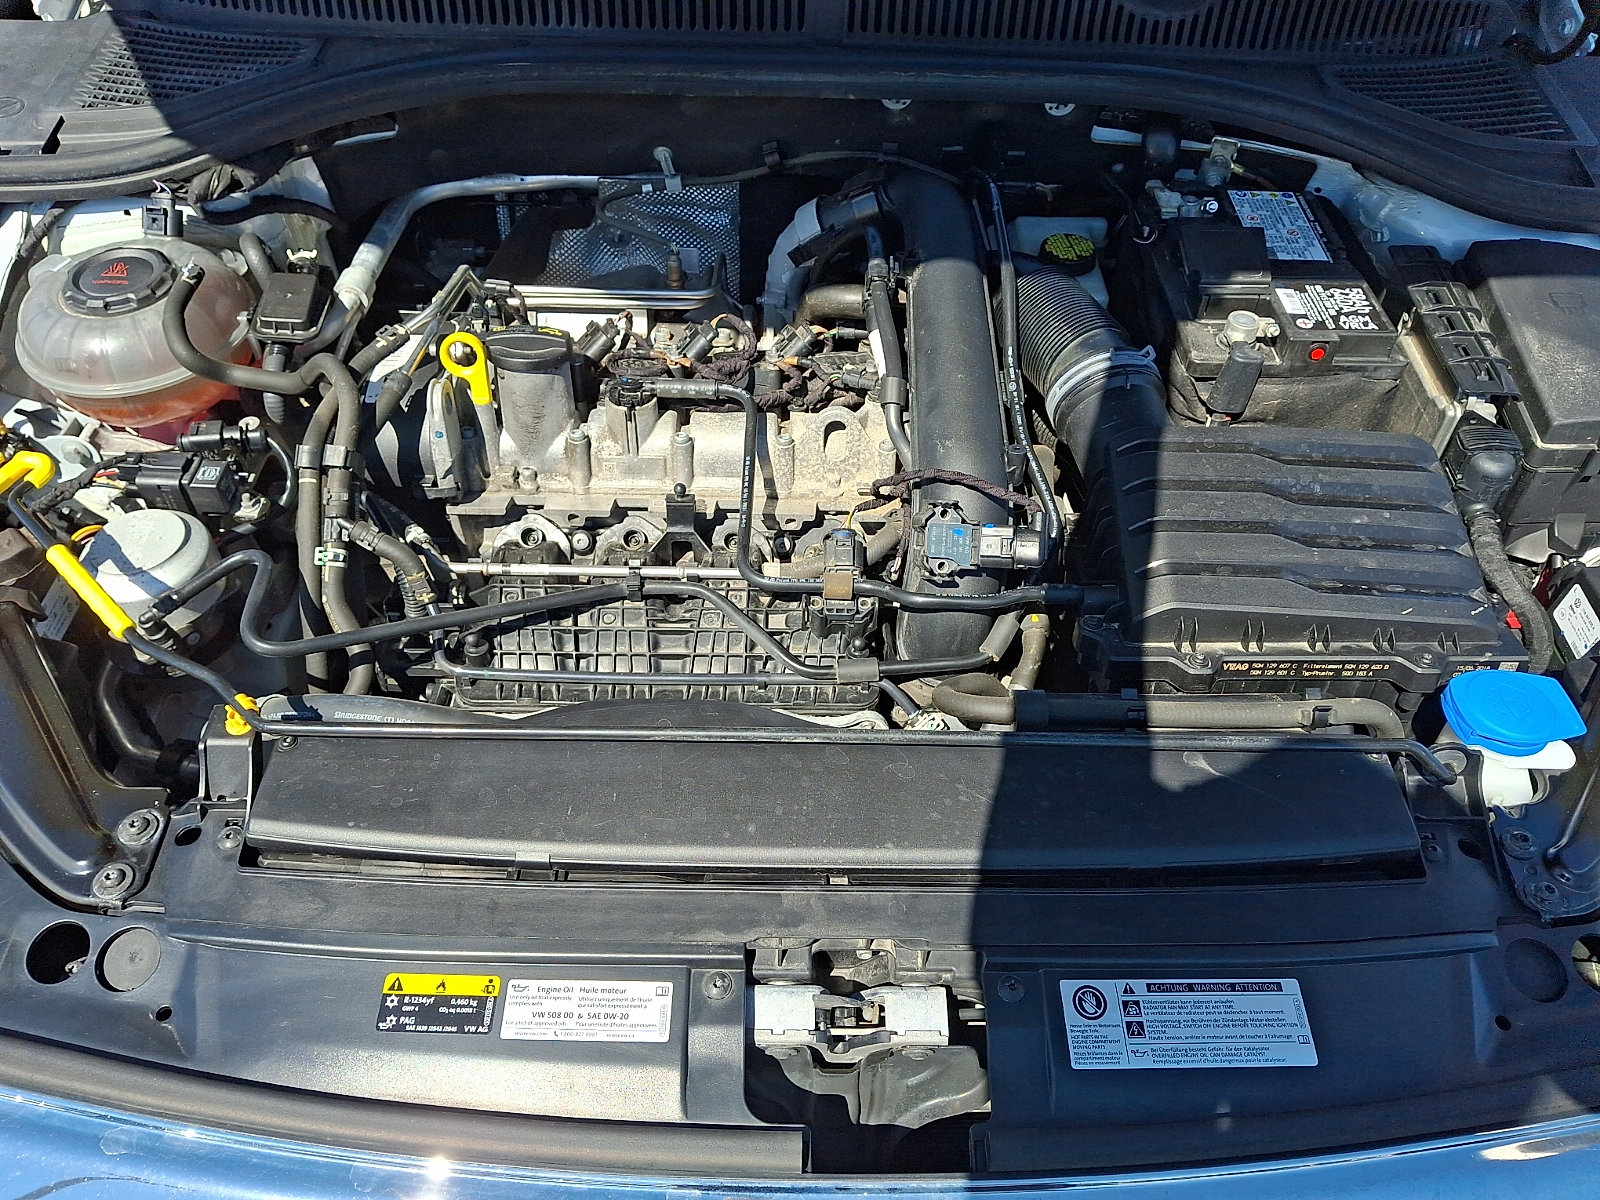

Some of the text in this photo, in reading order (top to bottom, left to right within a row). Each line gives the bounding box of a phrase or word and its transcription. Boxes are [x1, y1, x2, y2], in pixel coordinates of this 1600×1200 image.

[334, 712, 382, 721] BRIDGESTONE
[538, 986, 561, 994] Engine
[404, 996, 435, 1006] R-1234yf
